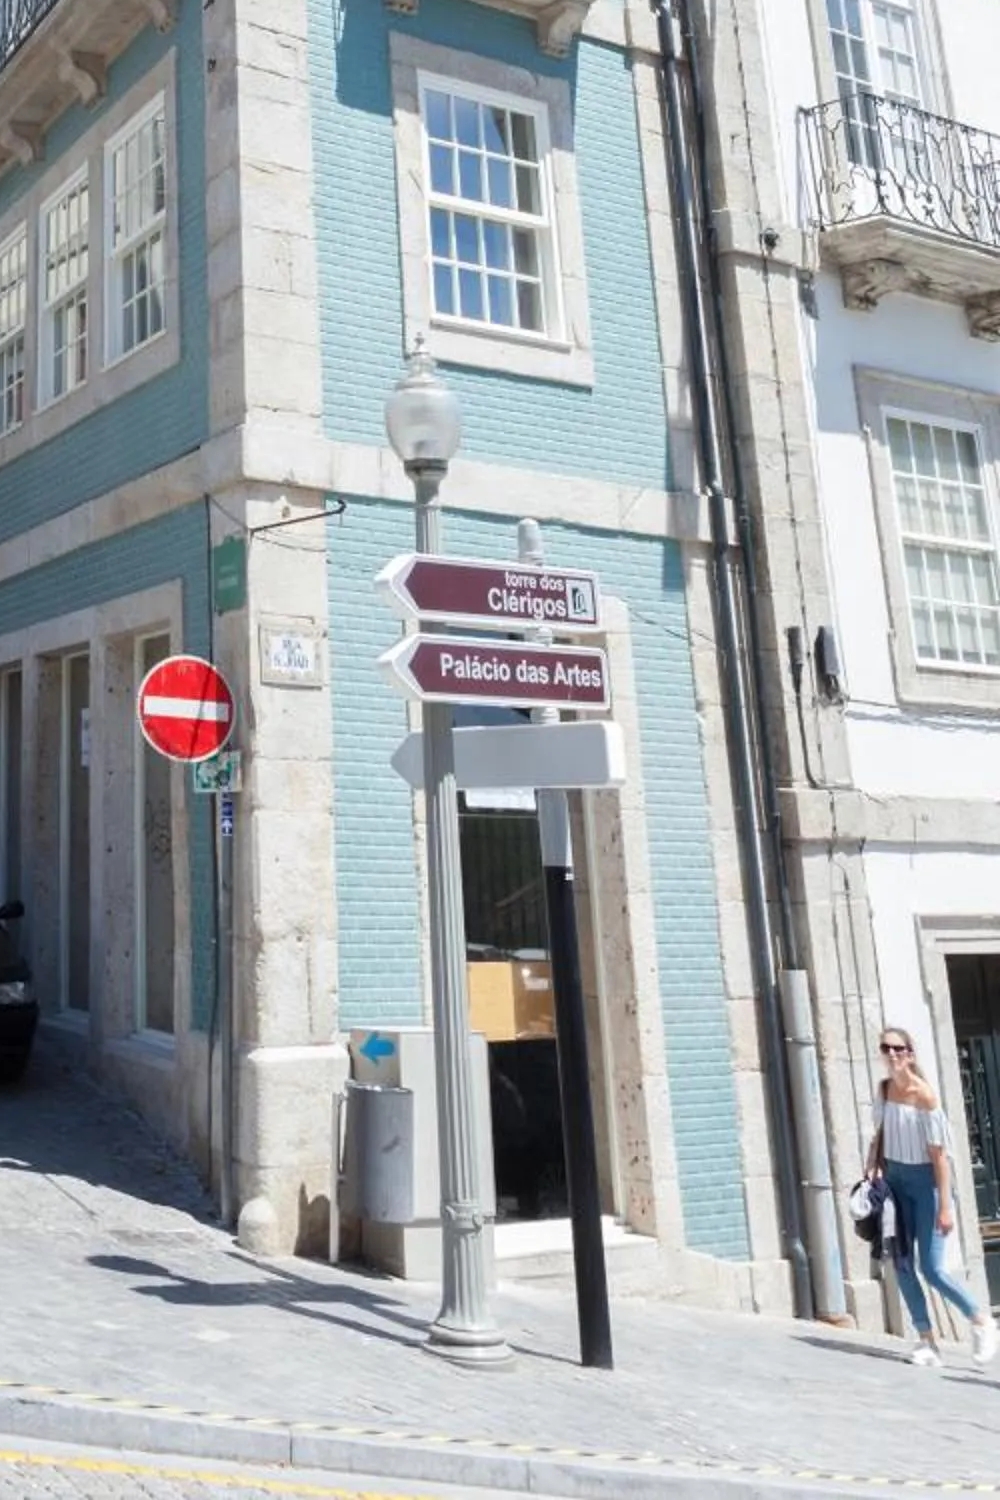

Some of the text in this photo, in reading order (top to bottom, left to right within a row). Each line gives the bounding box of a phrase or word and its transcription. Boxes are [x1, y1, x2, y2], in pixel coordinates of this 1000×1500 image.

[505, 571, 565, 592] torre dos
[487, 587, 567, 620] Clérigos
[440, 652, 602, 688] Palácio das Artes
